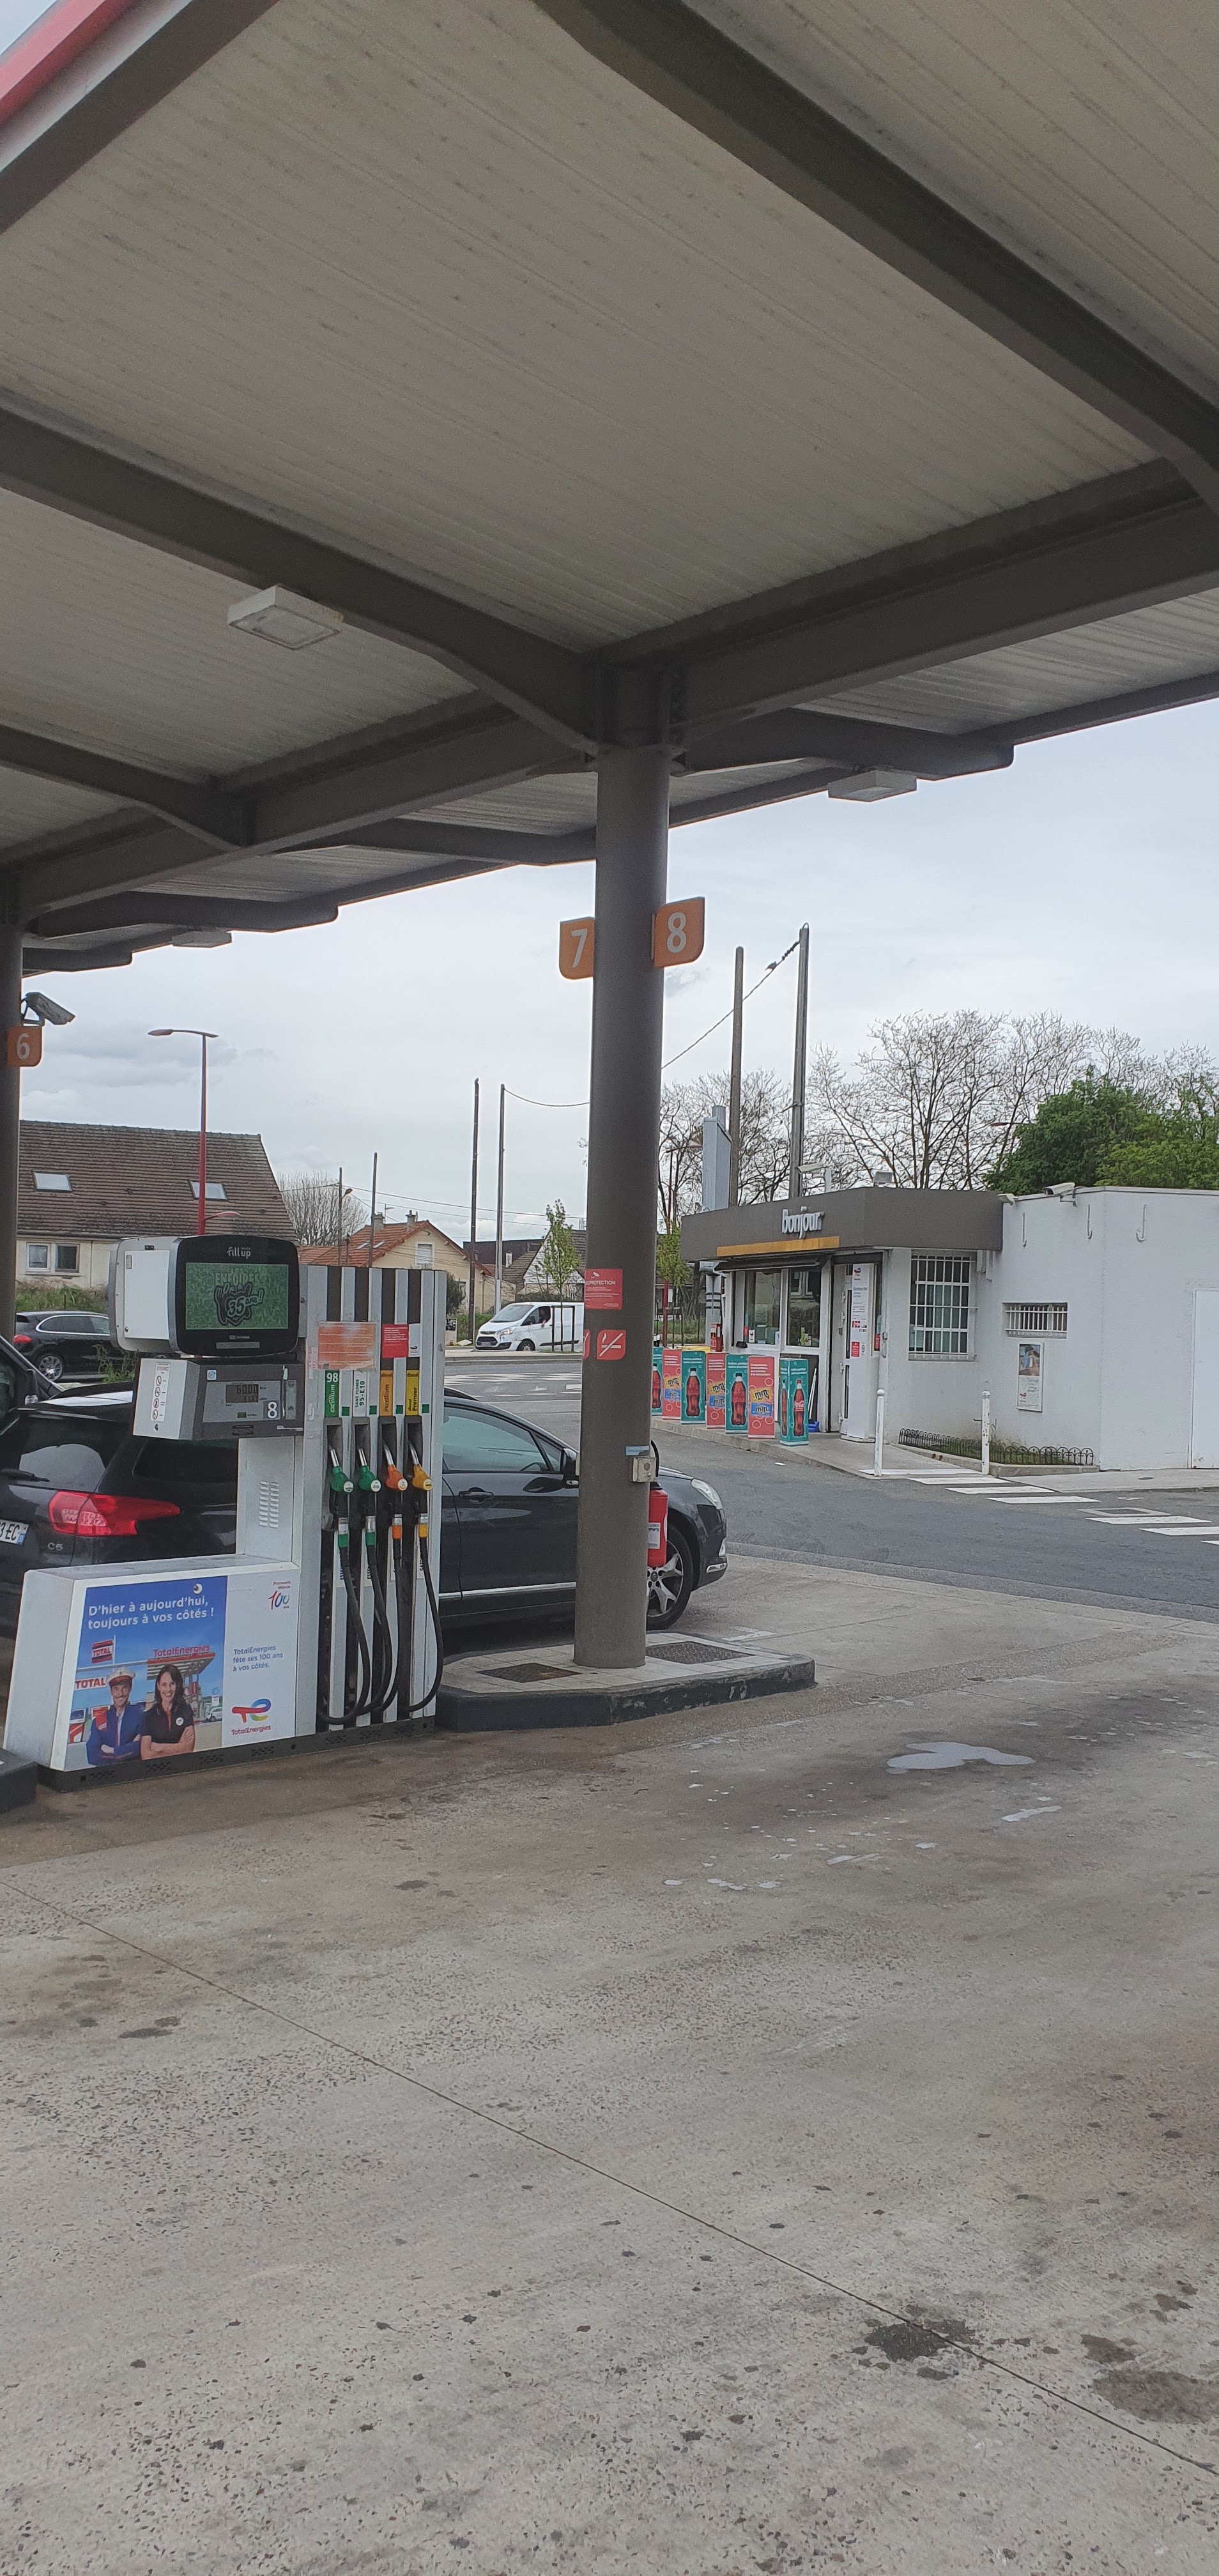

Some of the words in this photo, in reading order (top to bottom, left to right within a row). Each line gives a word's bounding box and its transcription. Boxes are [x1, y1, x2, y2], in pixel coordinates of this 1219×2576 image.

[666, 912, 687, 953] 8
[571, 928, 588, 968] 7
[17, 1032, 30, 1060] 6
[781, 1206, 824, 1239] bonjour
[241, 1250, 251, 1259] up
[227, 1296, 245, 1317] 35
[326, 1372, 339, 1383] 98
[267, 1401, 277, 1419] 8
[5, 1524, 20, 1540] EC
[48, 1542, 63, 1551] C5
[88, 1604, 125, 1616] D'hier
[128, 1602, 135, 1613] à
[139, 1595, 208, 1612] aujourd'hui,
[88, 1616, 139, 1630] toujours
[142, 1613, 148, 1624] à
[153, 1613, 172, 1622] vos
[176, 1608, 207, 1620] côtés
[210, 1607, 214, 1617] !
[93, 1647, 111, 1657] TOTAL
[153, 1644, 210, 1657] TotalEnergies
[234, 1645, 276, 1655] TotalEnergies
[75, 1677, 106, 1689] TOTAL
